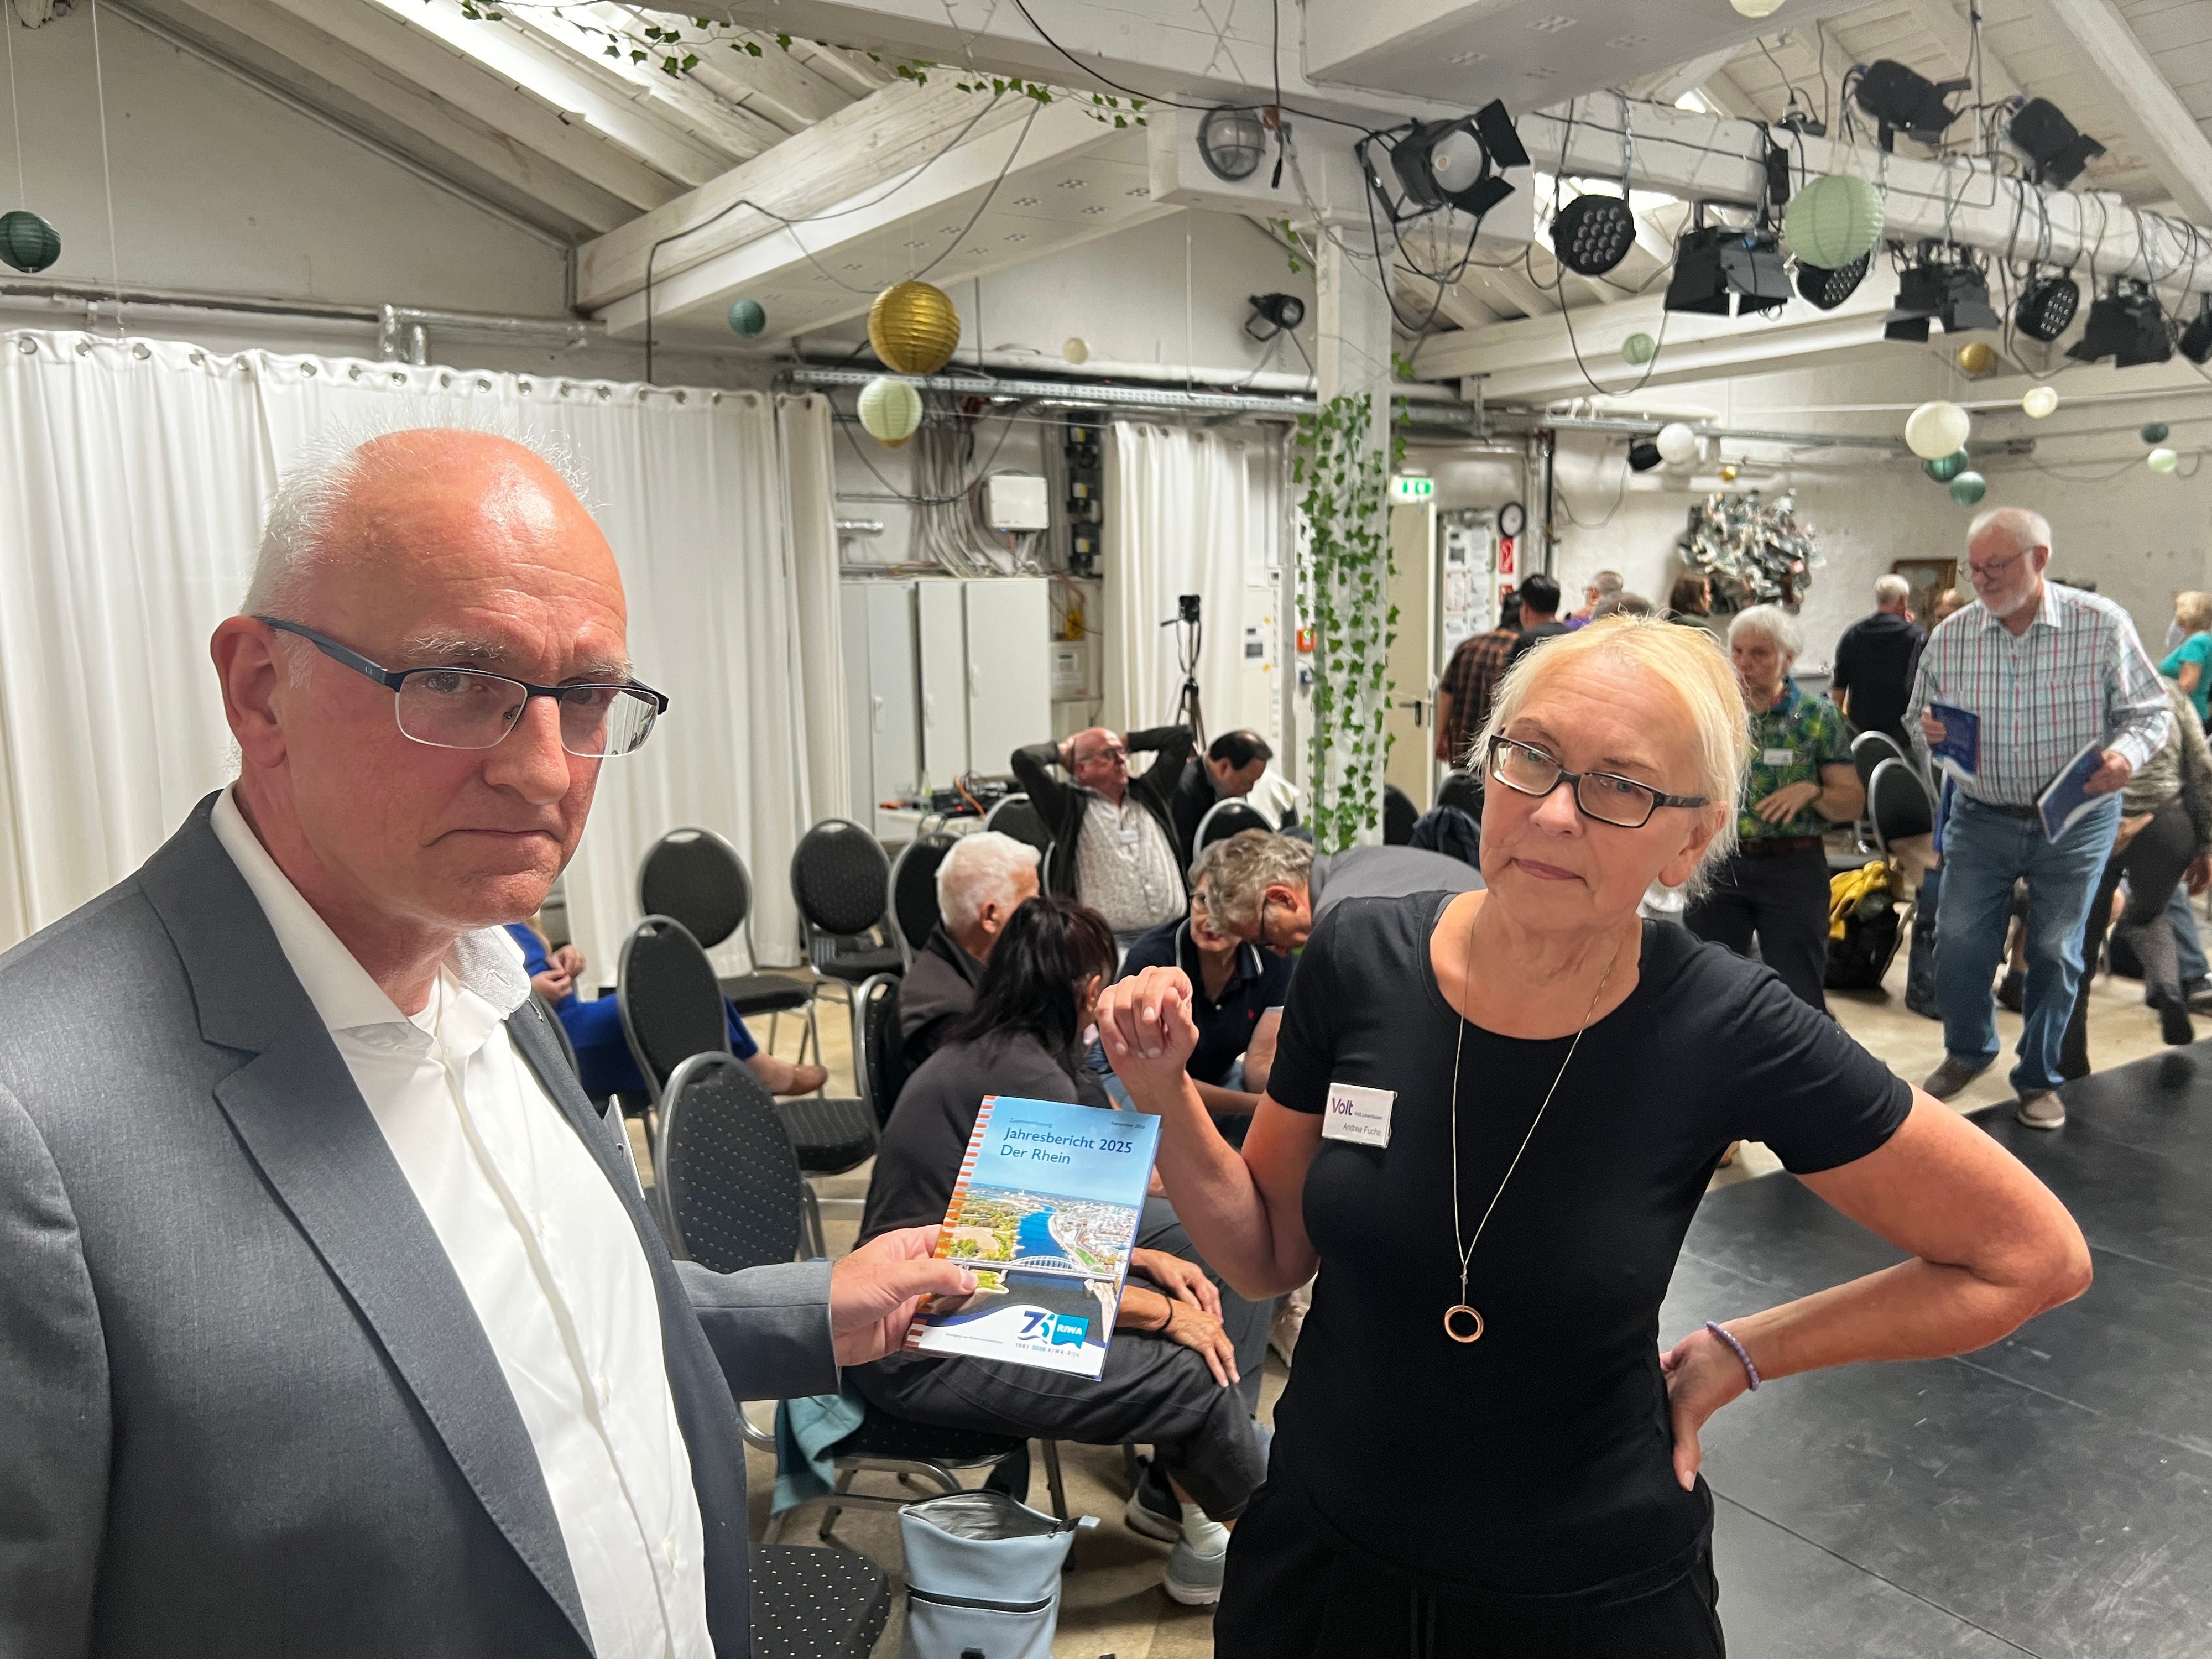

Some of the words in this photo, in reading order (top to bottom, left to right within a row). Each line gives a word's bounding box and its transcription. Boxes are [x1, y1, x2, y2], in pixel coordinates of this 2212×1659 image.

[1332, 1097, 1353, 1116] Volt
[1343, 1123, 1363, 1133] Andrea
[1363, 1126, 1381, 1136] Fuchs
[1003, 1126, 1095, 1149] Jahresbericht
[1098, 1139, 1133, 1154] 2025
[1000, 1144, 1028, 1158] Der
[1031, 1148, 1071, 1164] Rhein
[1056, 1324, 1083, 1336] RIWA
